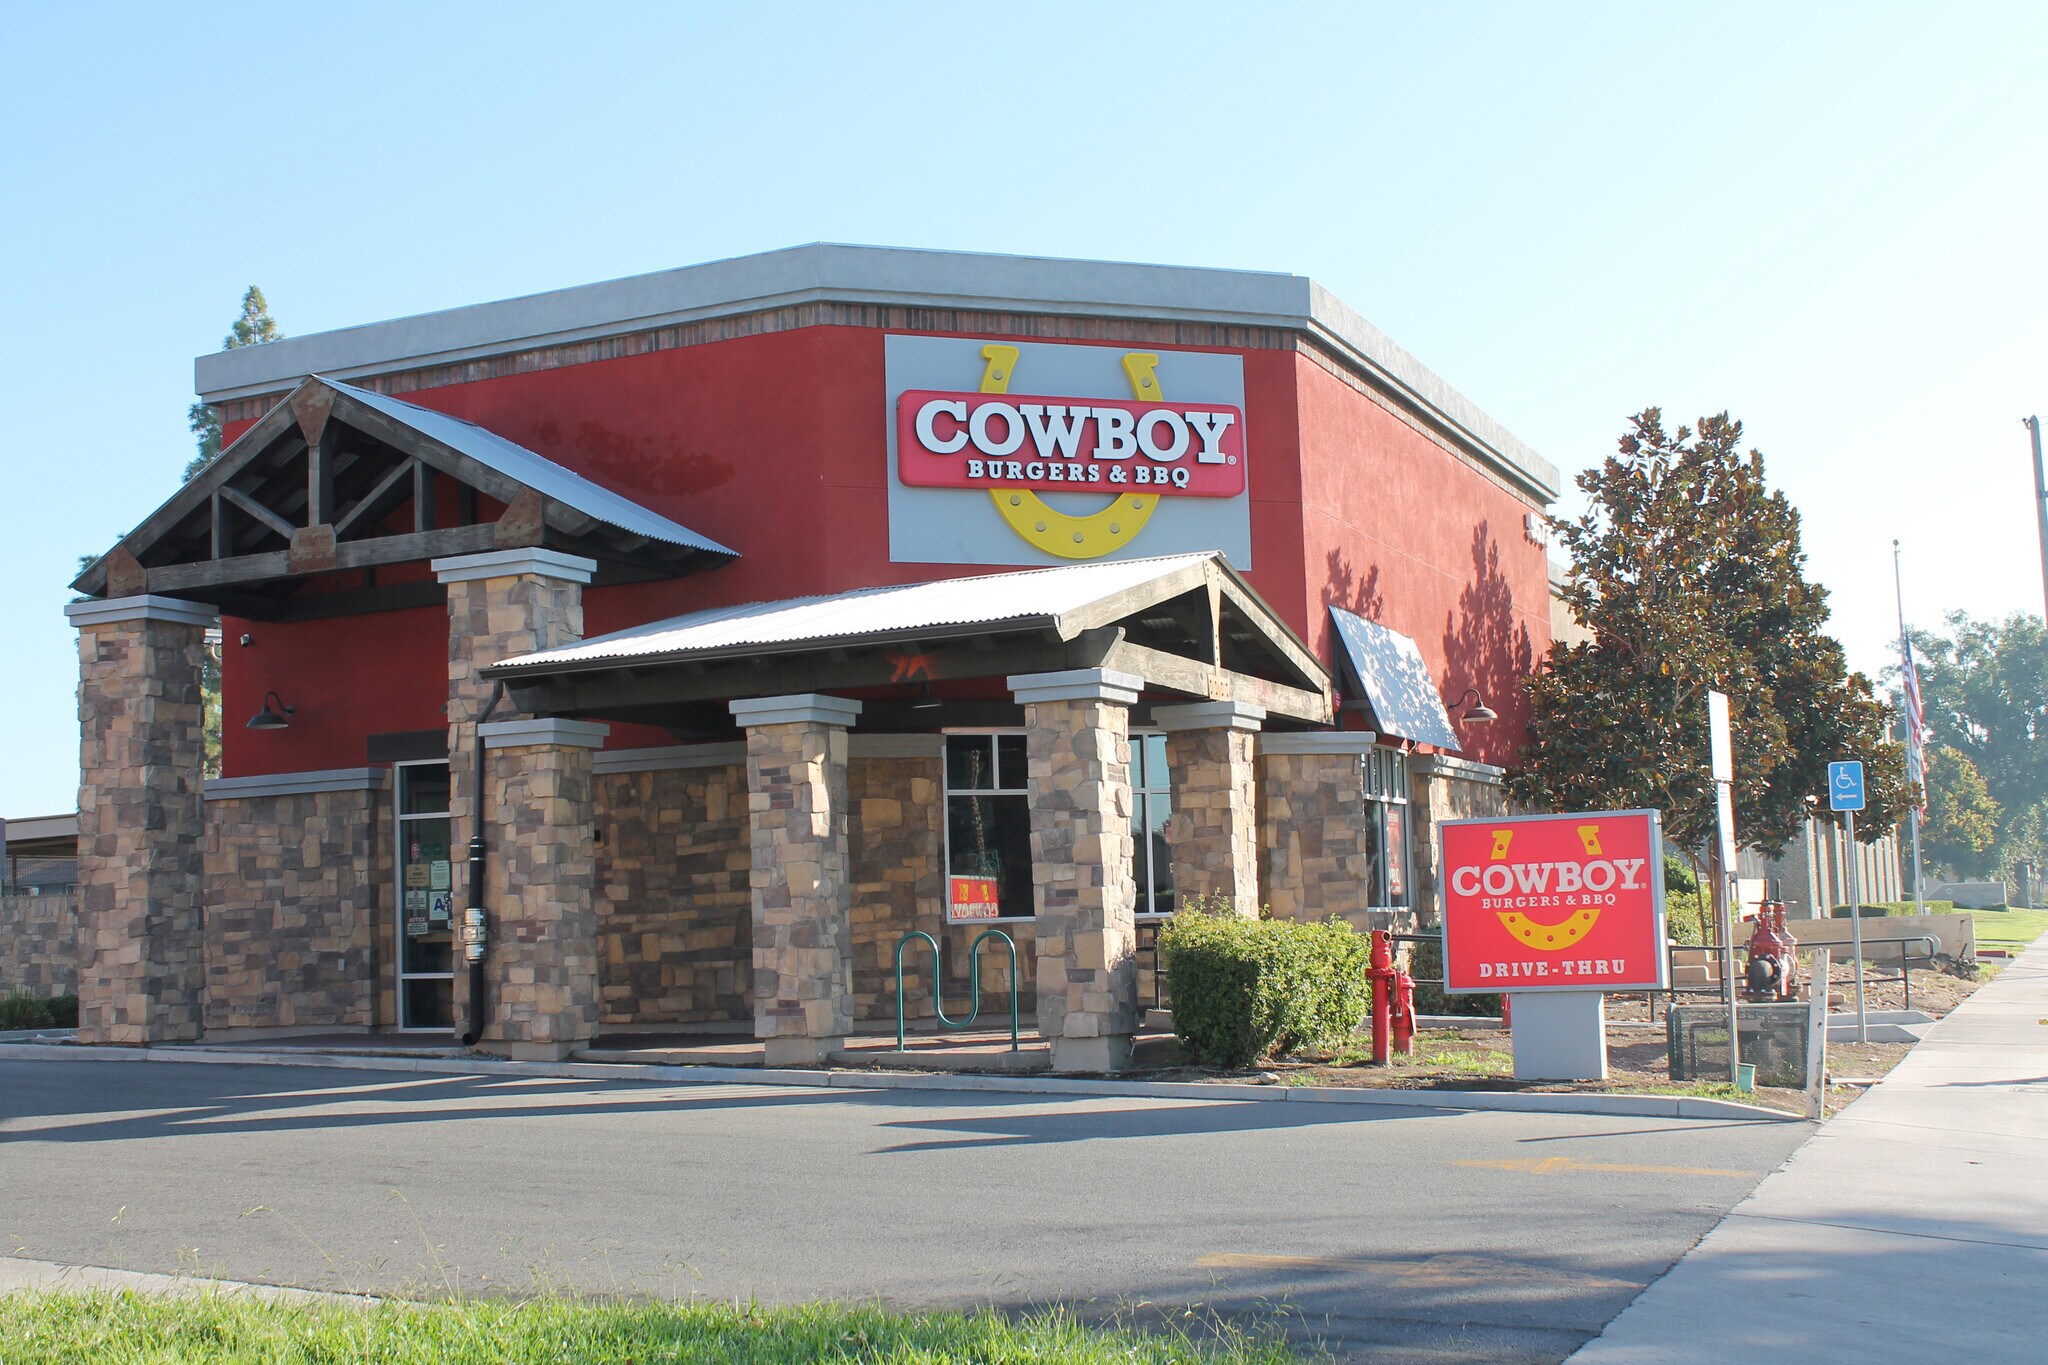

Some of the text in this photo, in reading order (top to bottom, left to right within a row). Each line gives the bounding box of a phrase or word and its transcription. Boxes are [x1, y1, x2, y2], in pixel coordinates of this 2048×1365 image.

[915, 399, 1235, 464] COWBOY
[968, 459, 1190, 489] BURGERS & BBQ
[1451, 858, 1646, 897] COWBOY
[1481, 893, 1616, 909] BURGERS & BBQ
[1479, 959, 1625, 978] DRIVE-THRU
